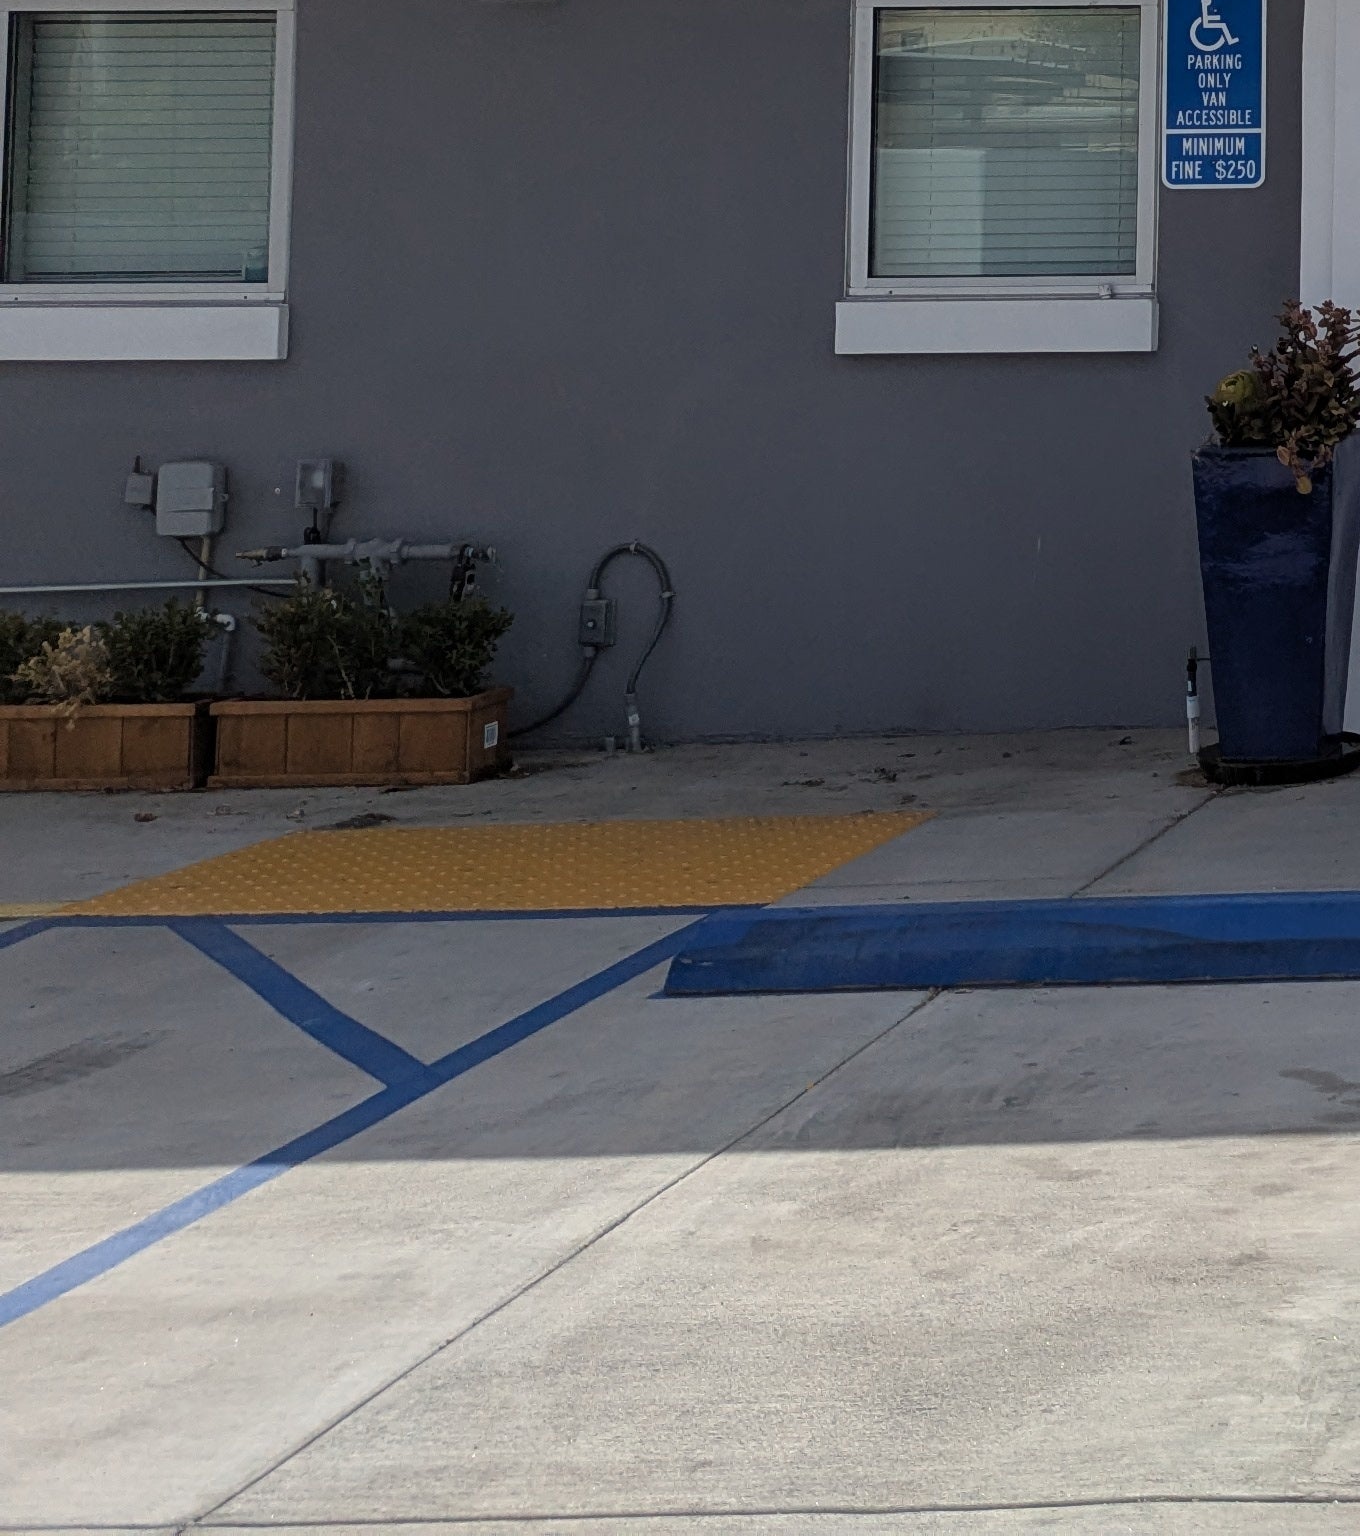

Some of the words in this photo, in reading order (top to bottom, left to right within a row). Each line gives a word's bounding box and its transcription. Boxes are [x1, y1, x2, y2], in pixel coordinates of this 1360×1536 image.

[1187, 54, 1242, 70] PARKING
[1198, 73, 1232, 88] ONLY
[1202, 92, 1226, 107] VAN
[1176, 110, 1252, 126] ACCESSIBLE
[1182, 137, 1245, 156] MINIMUM
[1171, 161, 1202, 179] FINE
[1215, 159, 1256, 180] $250
